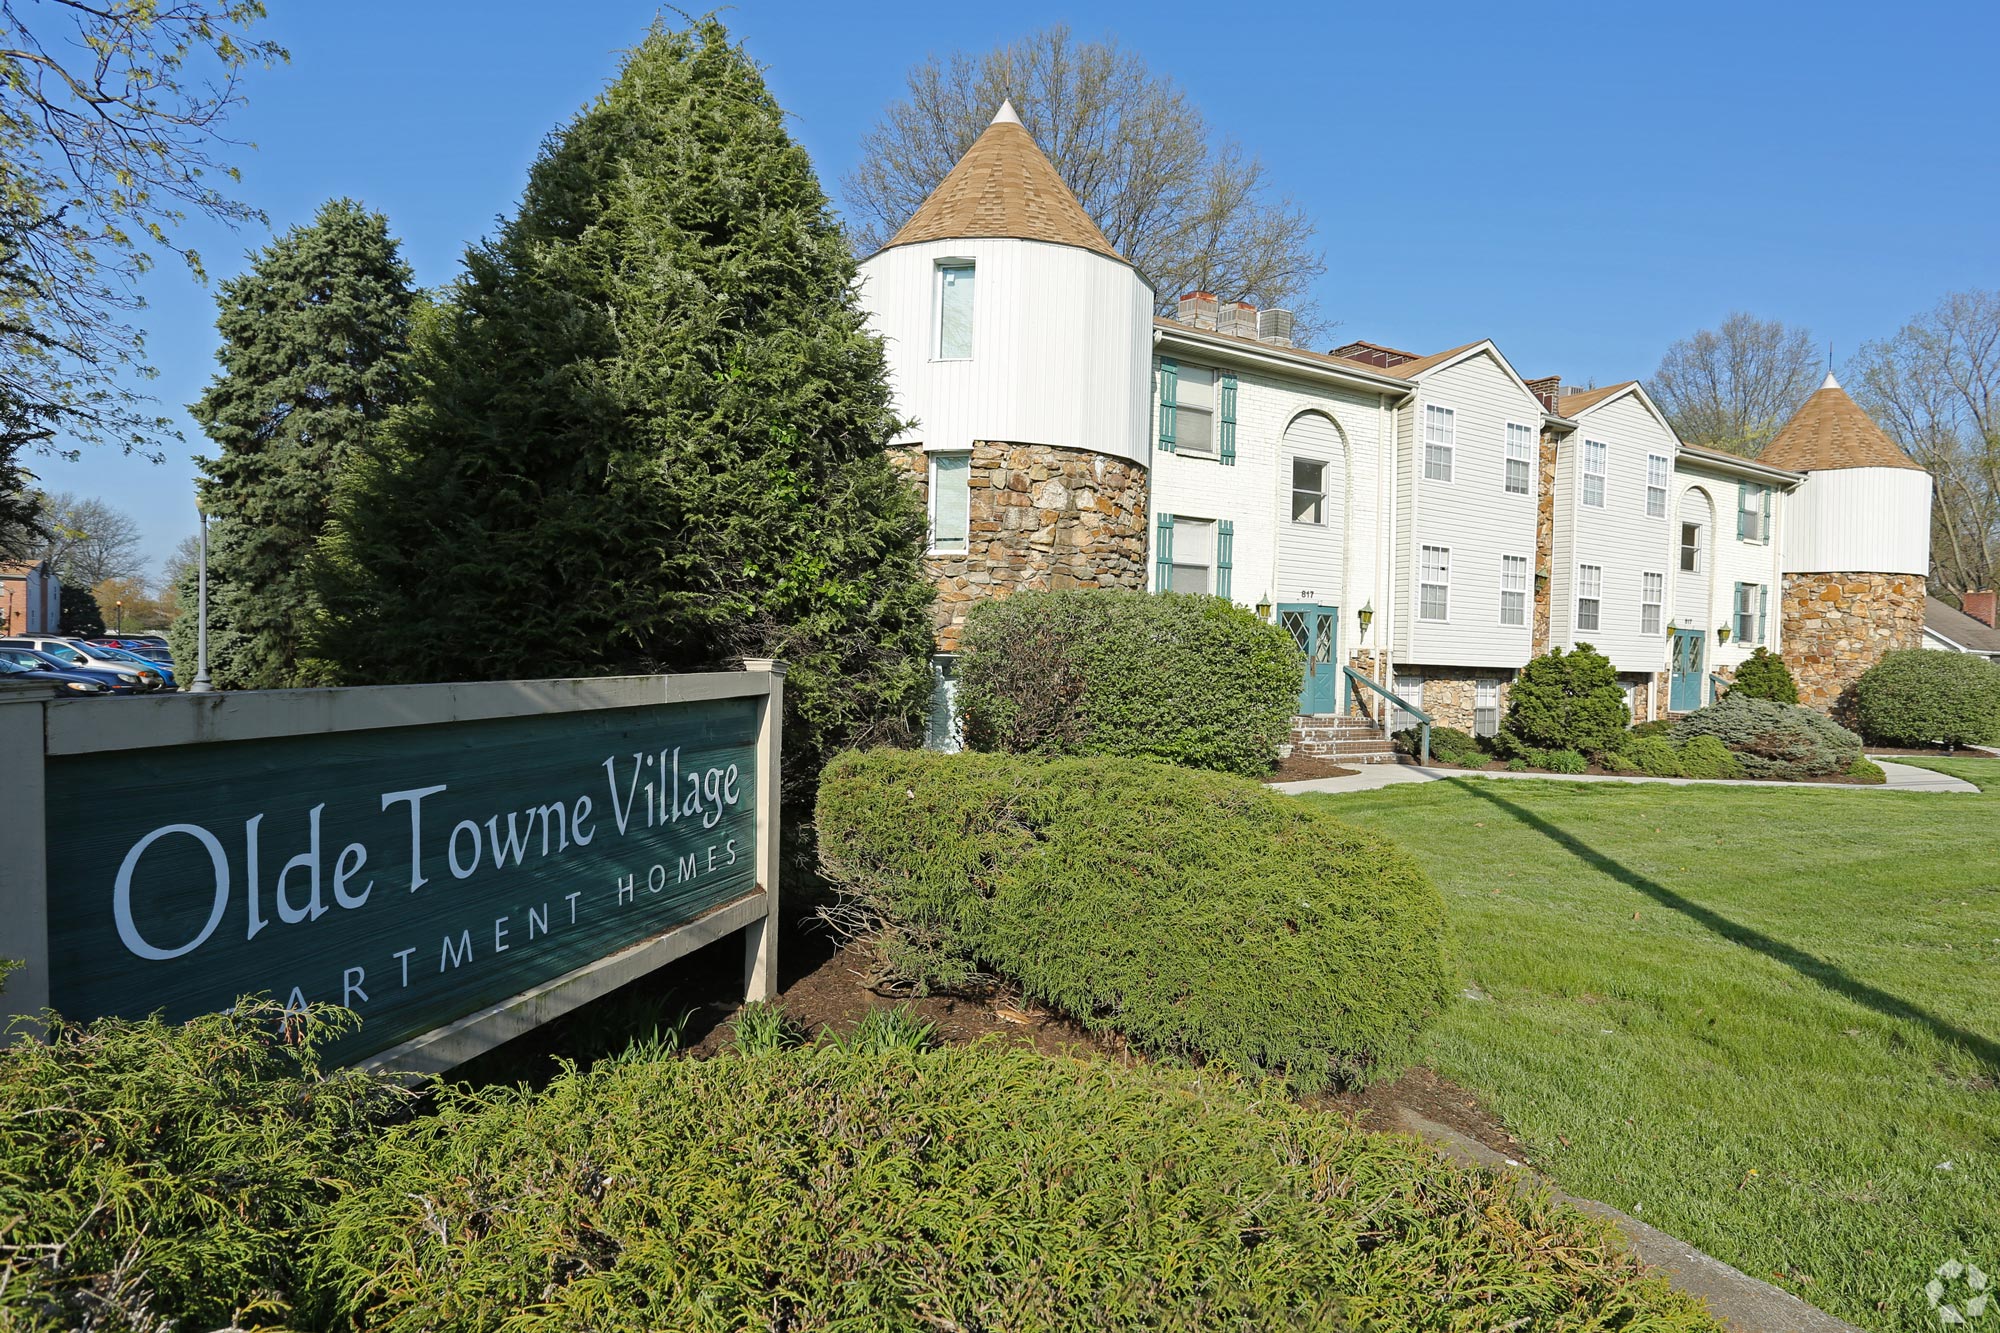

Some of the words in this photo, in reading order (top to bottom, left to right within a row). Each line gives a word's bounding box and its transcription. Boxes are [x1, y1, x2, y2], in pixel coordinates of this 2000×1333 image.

[1301, 590, 1314, 599] 817
[113, 801, 374, 961] Olde
[381, 784, 596, 894] Towne
[602, 745, 741, 830] Village
[219, 890, 582, 1034] ARTMENT
[617, 838, 738, 907] HOMES
